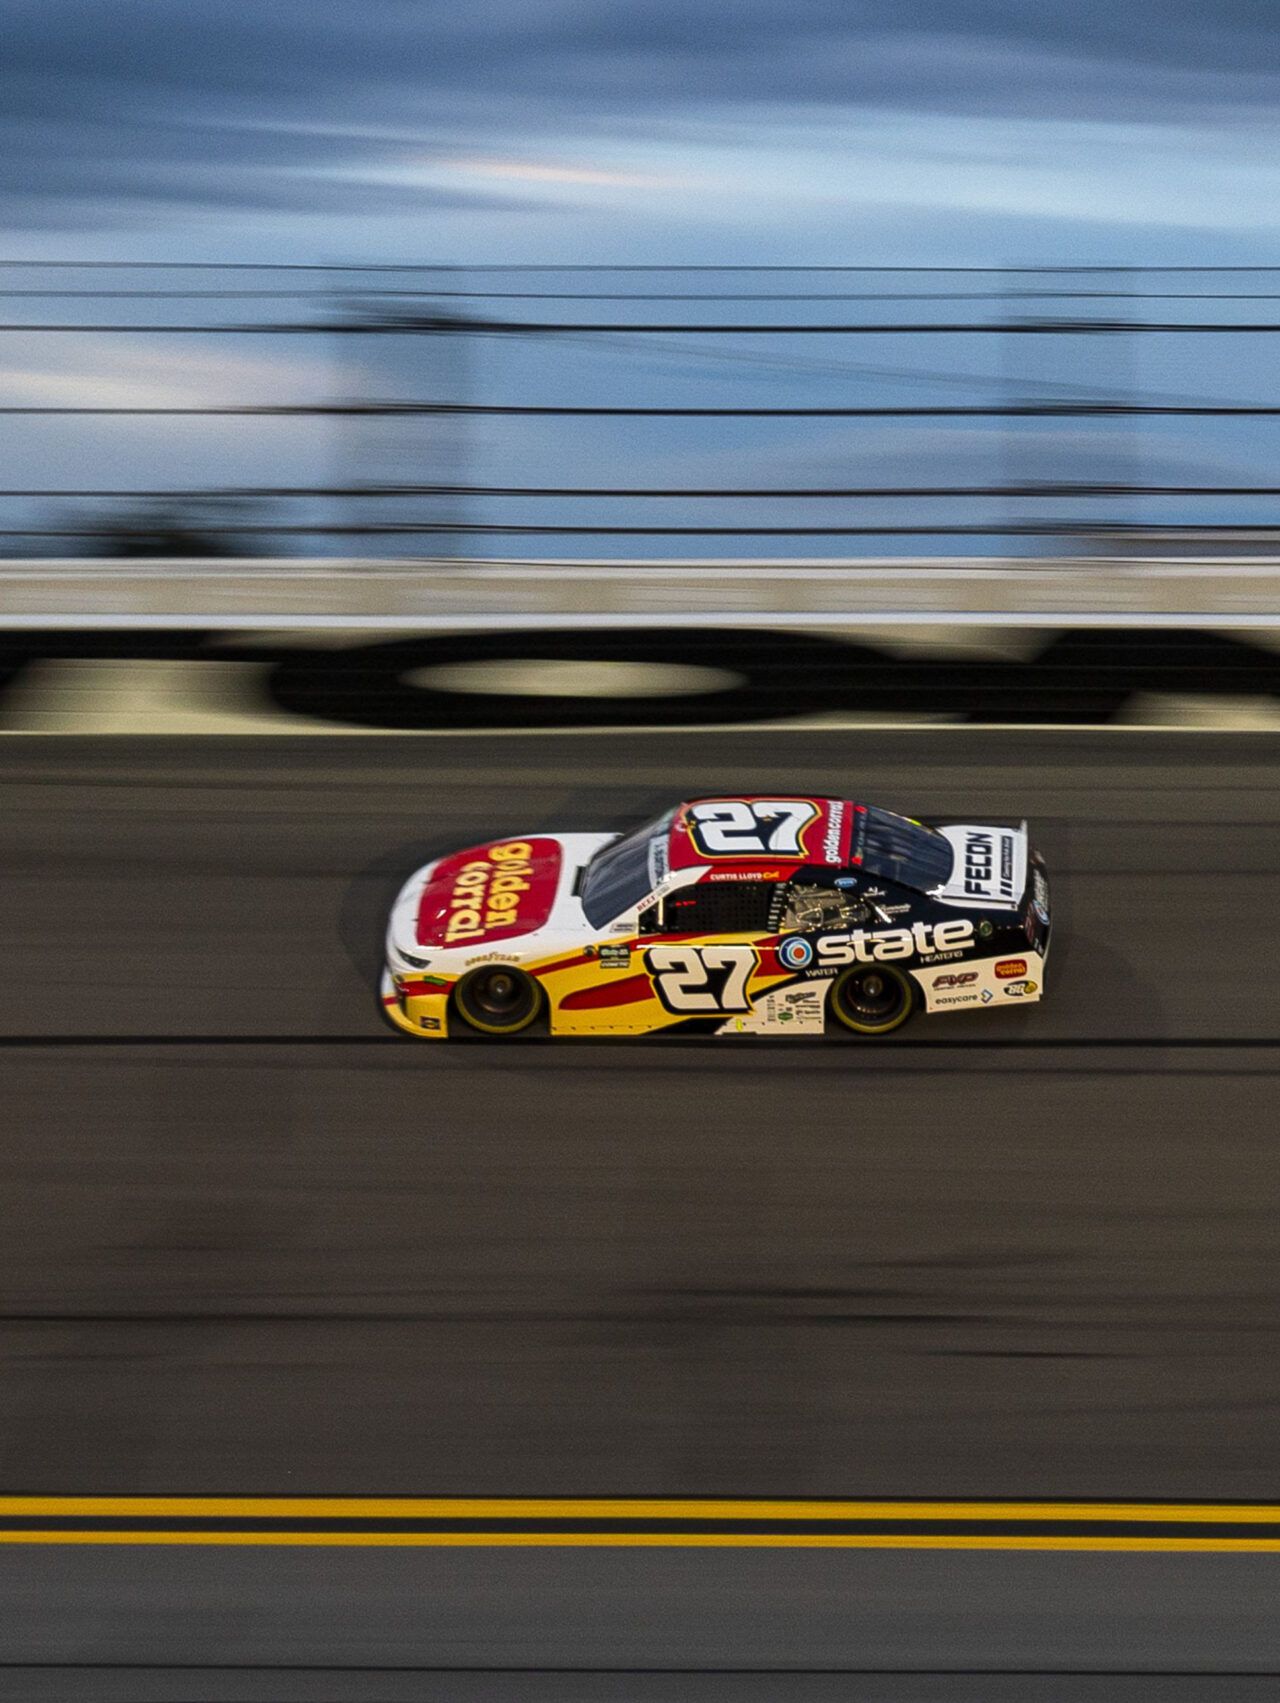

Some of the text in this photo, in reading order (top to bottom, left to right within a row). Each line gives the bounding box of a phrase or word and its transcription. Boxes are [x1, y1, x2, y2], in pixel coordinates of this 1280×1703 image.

[691, 801, 816, 851] 27
[485, 841, 534, 930] golden
[710, 873, 738, 881] CURTIS
[739, 872, 763, 880] LLOYD
[964, 832, 994, 896] FECON
[444, 860, 494, 943] corral
[816, 918, 976, 966] state
[649, 947, 756, 1010] 27
[805, 967, 838, 977] WATER
[935, 993, 978, 1006] easycare
